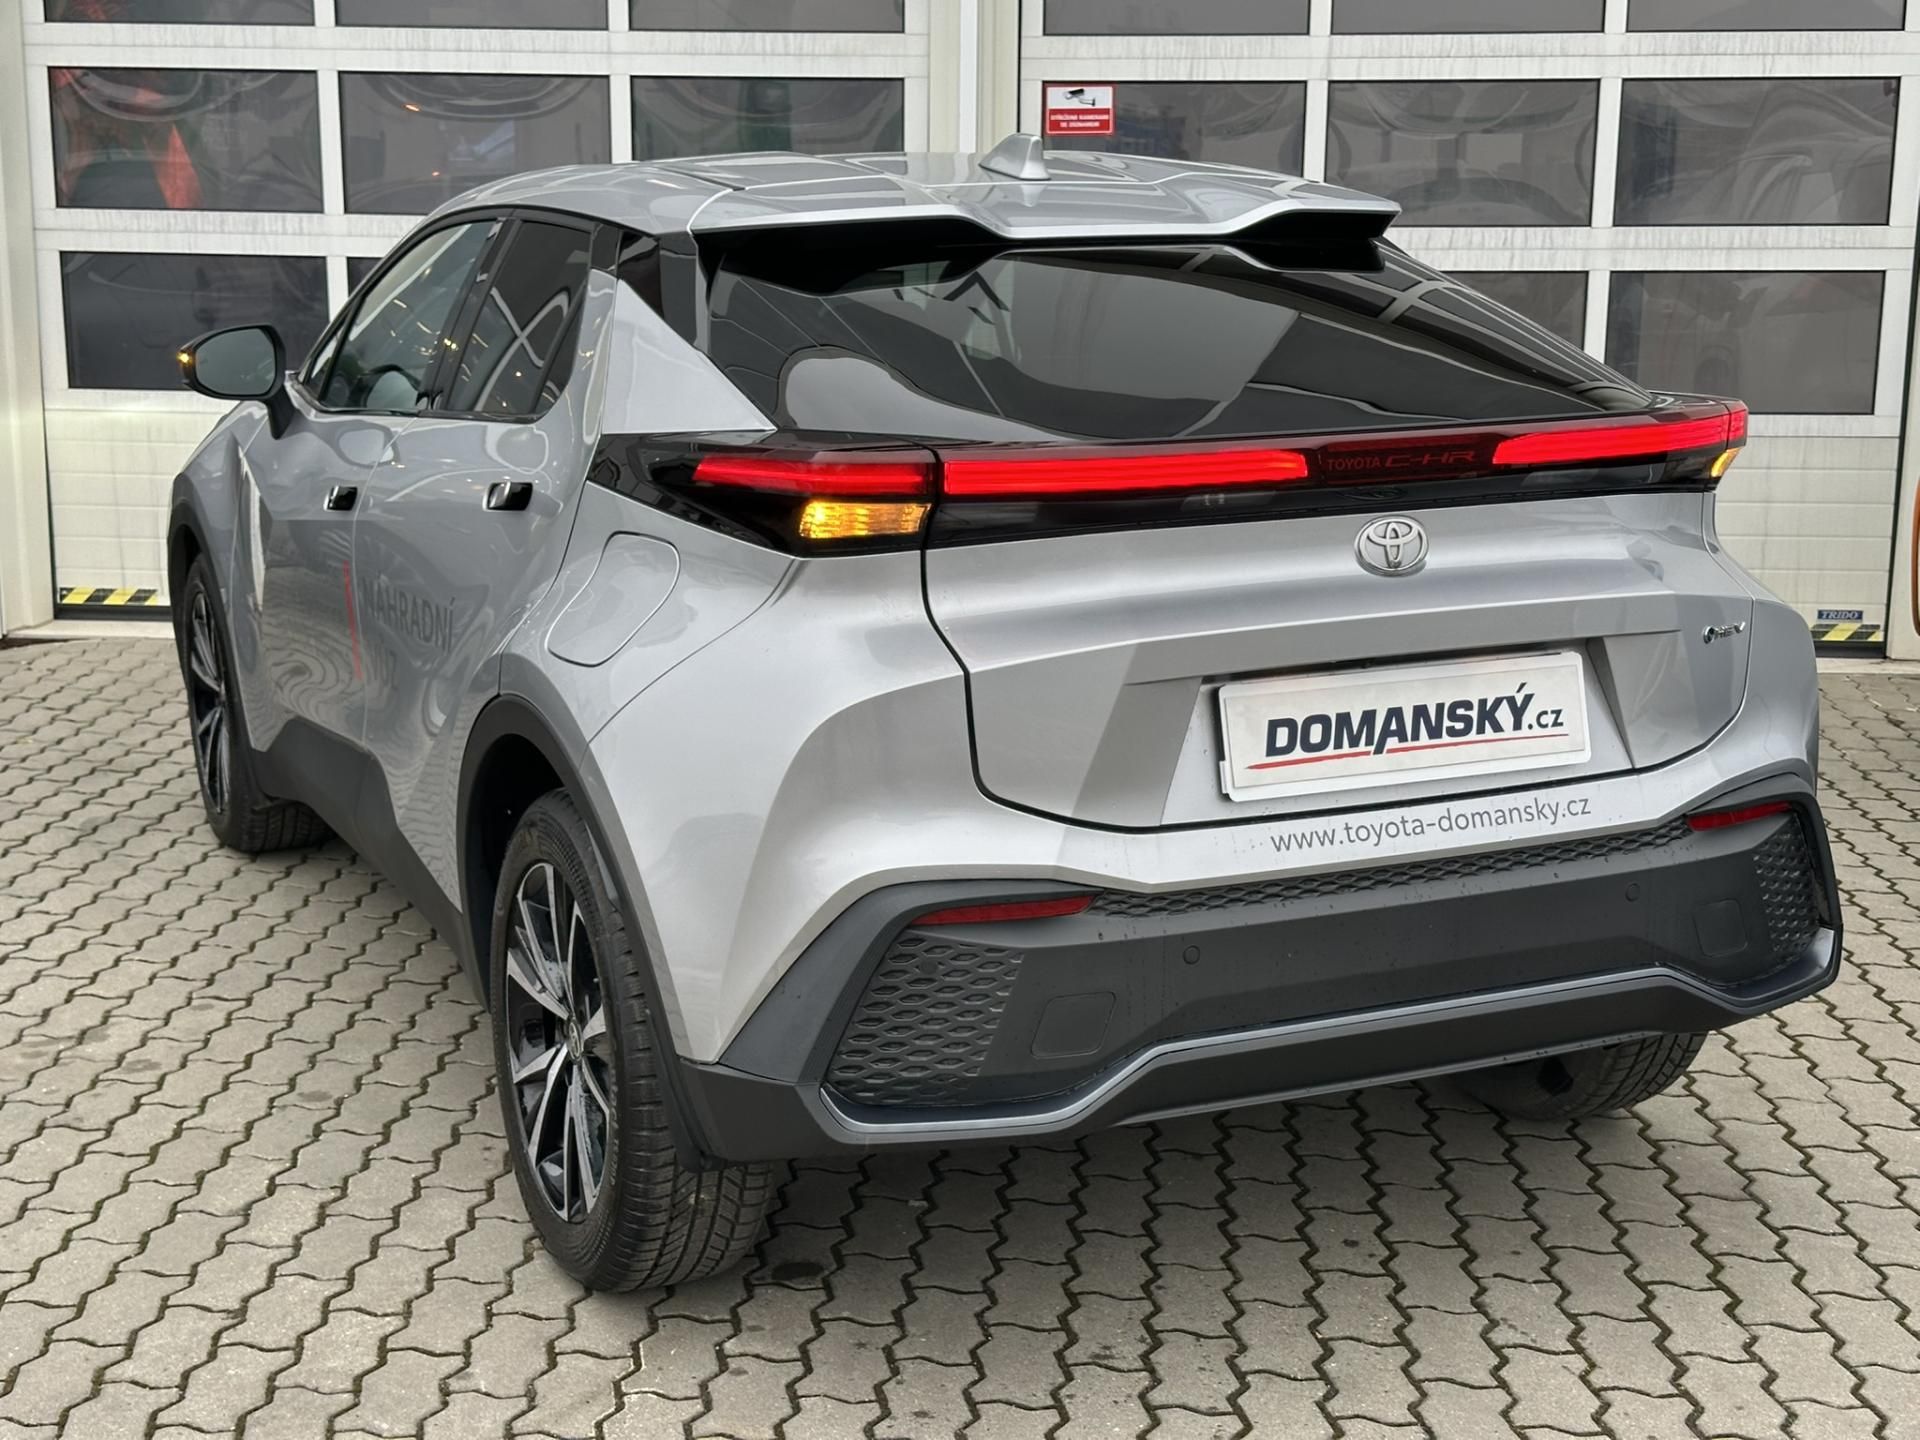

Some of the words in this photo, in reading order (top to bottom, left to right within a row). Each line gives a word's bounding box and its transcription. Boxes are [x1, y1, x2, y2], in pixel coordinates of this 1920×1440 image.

[1327, 456, 1382, 472] TOYOTA
[1385, 451, 1475, 468] C-HR
[361, 571, 456, 653] NÁHRADNÍ
[1820, 610, 1860, 620] TRIDO
[1265, 682, 1564, 757] DOMANSKÝ.cz
[1271, 797, 1592, 853] www.toyota-domansky.cz
